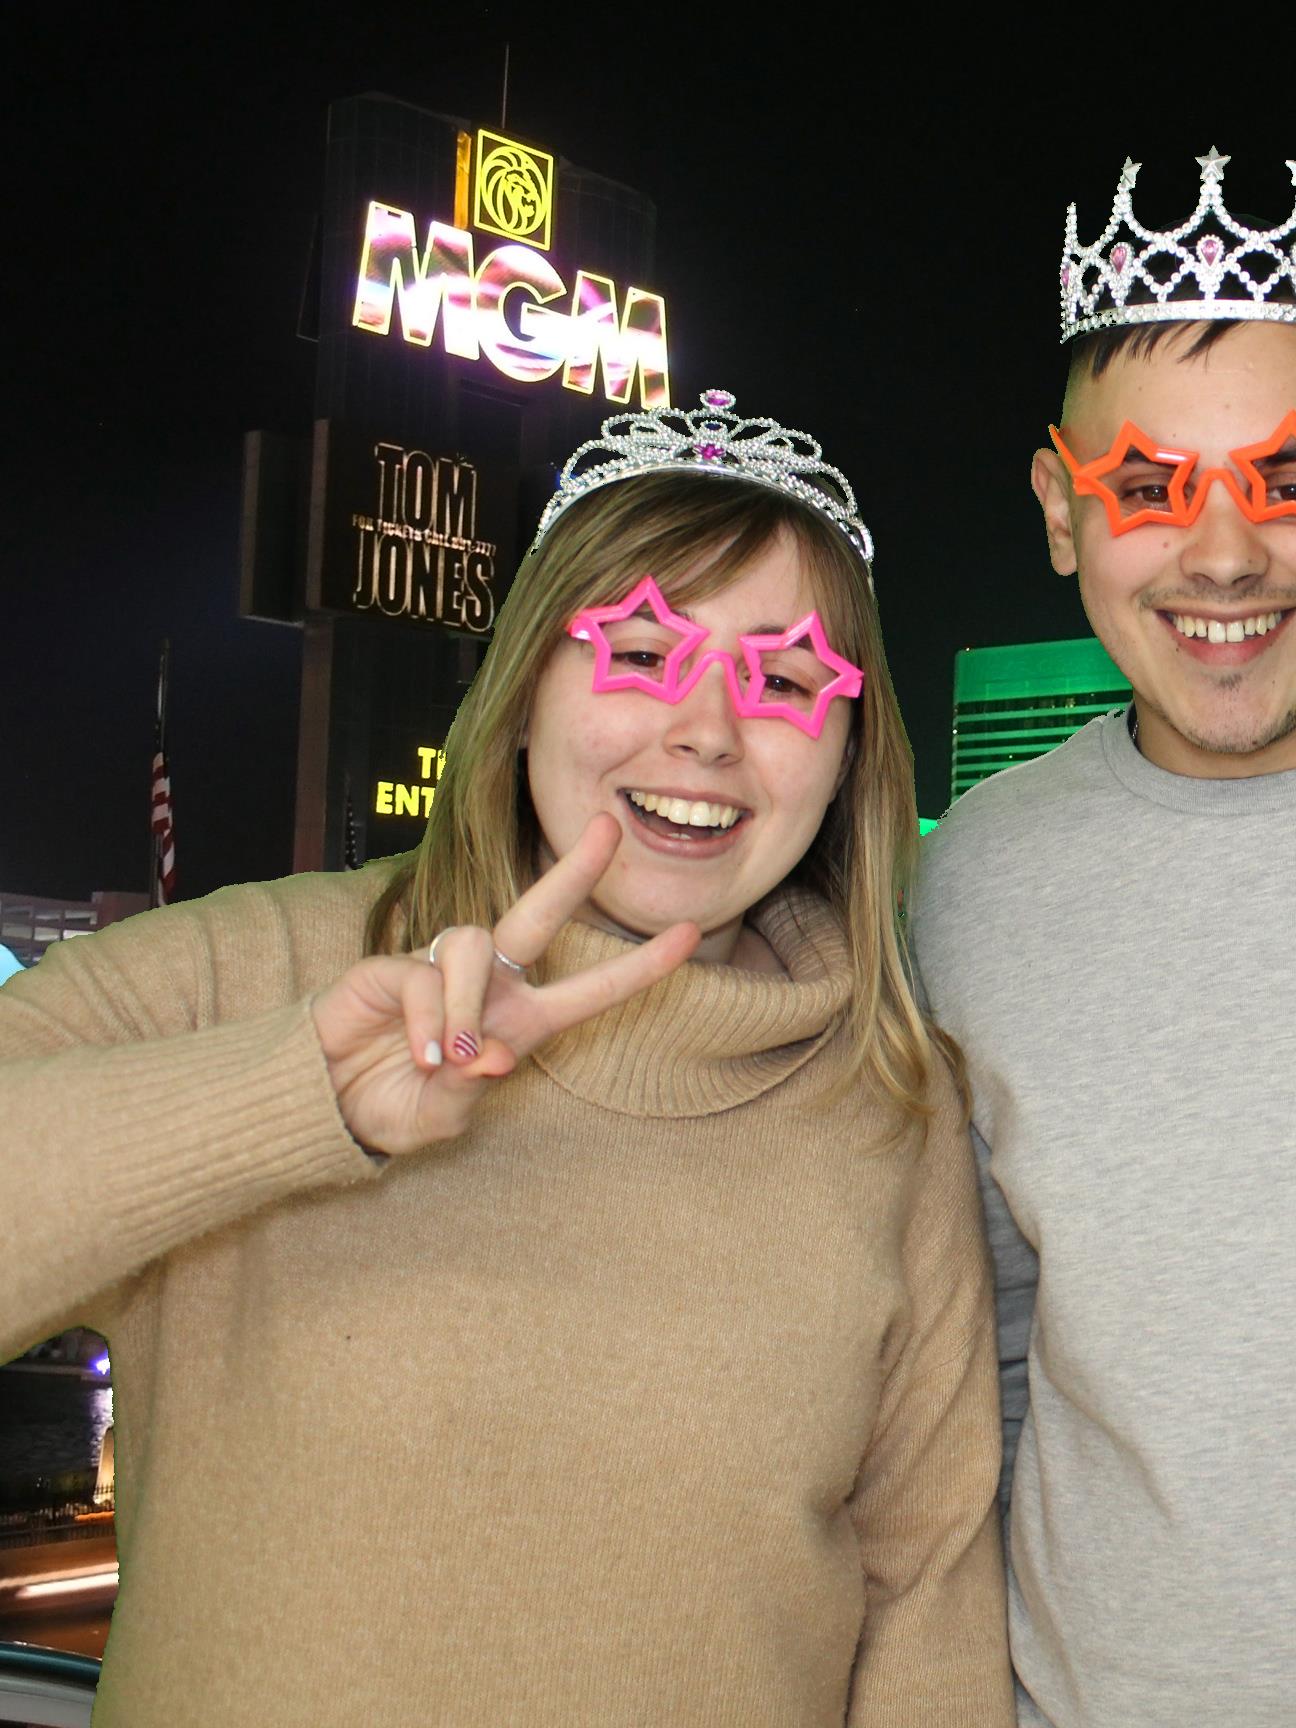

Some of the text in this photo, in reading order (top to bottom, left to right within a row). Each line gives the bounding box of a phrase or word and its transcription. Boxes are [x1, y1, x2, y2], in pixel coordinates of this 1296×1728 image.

[352, 200, 671, 411] MGM
[374, 442, 477, 541] TOM
[353, 530, 495, 632] JONES
[376, 781, 436, 818] ENT
[417, 746, 447, 780] T
